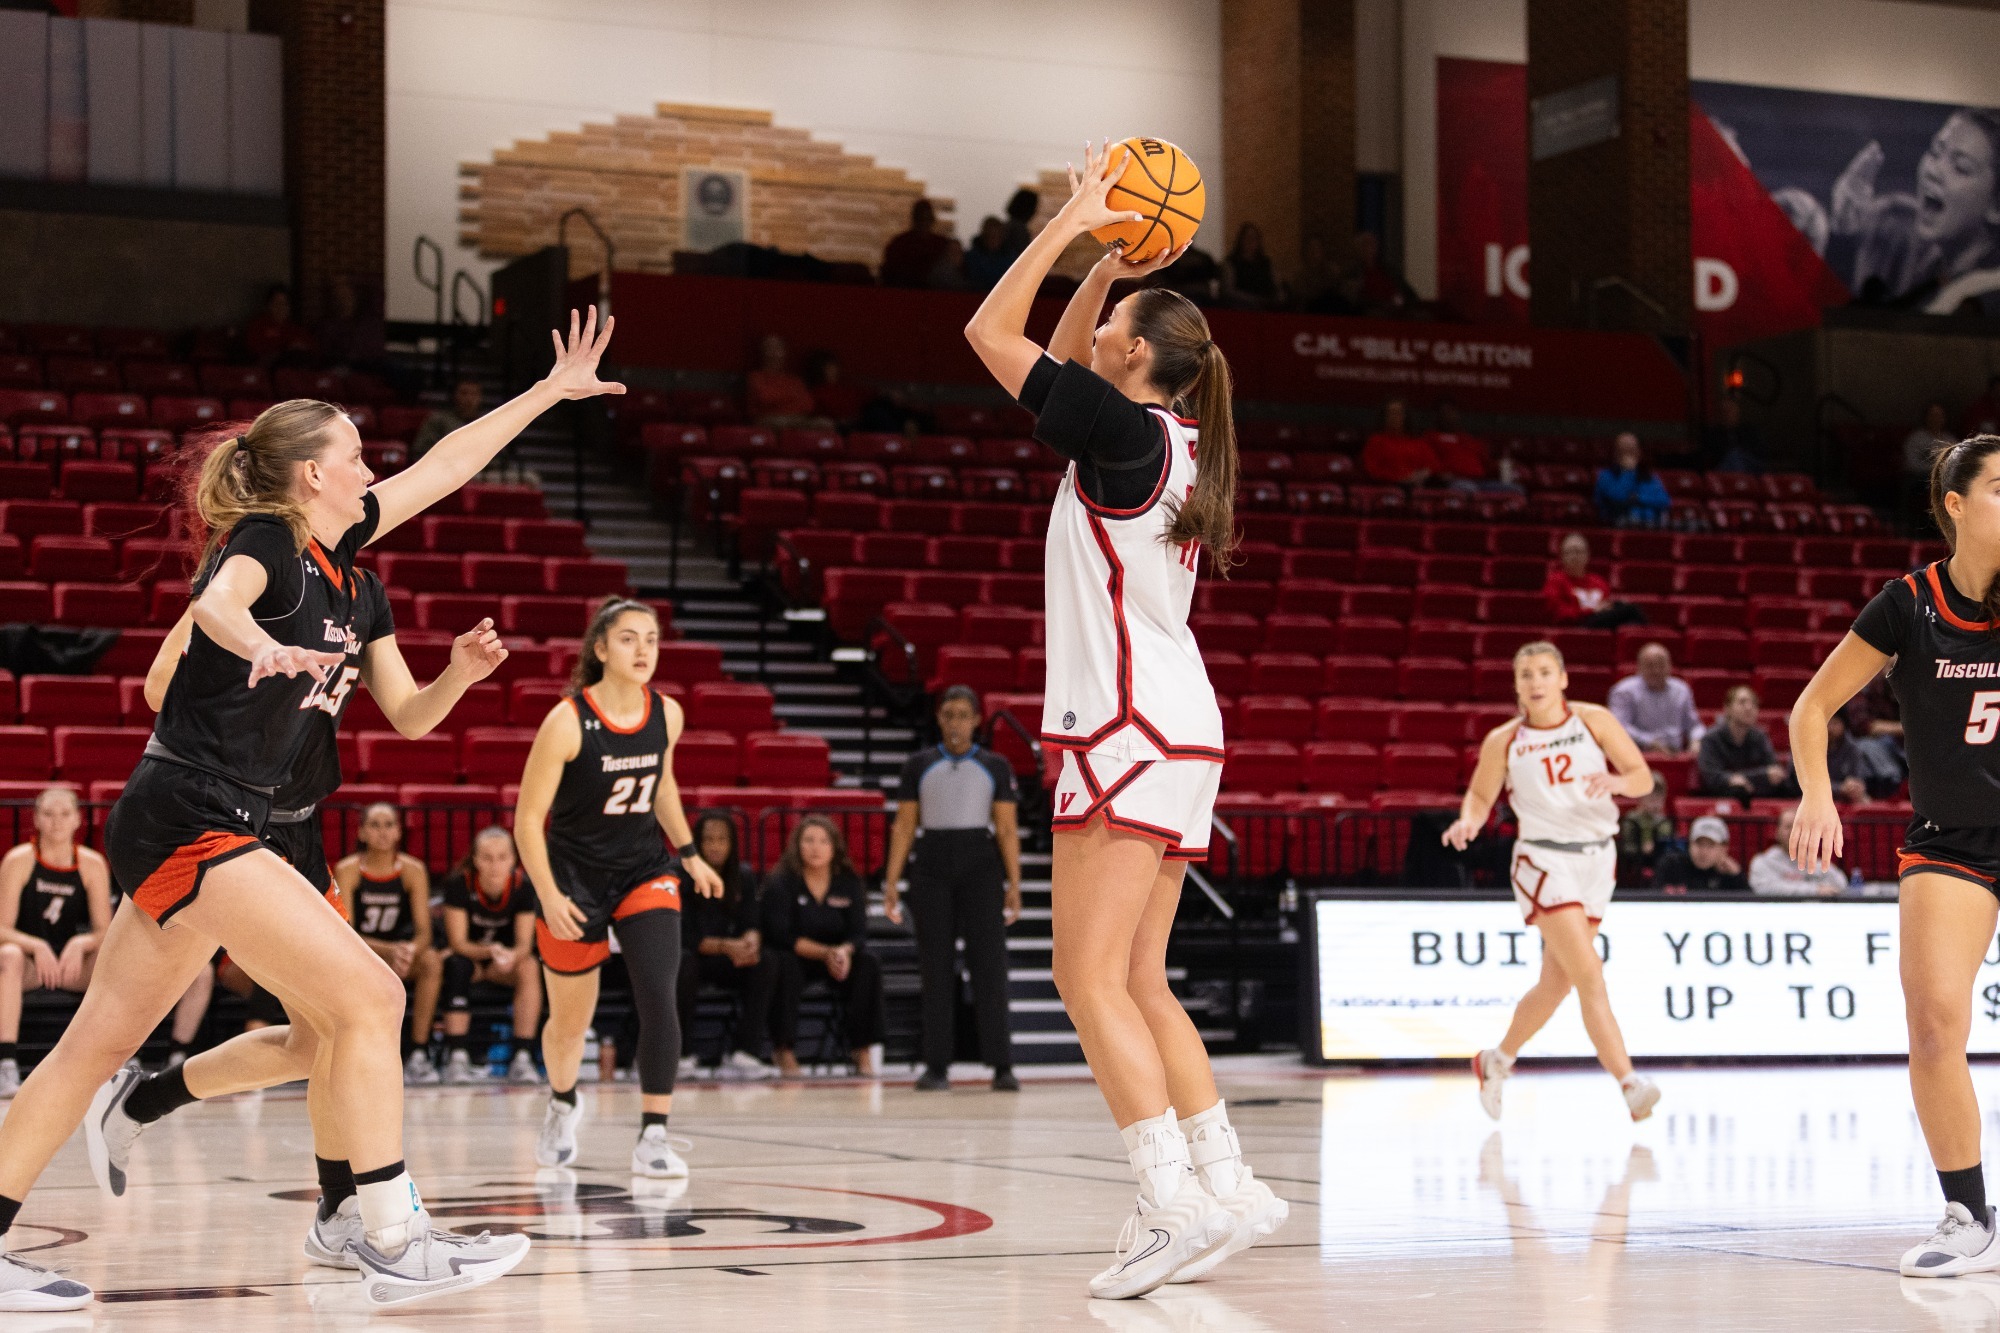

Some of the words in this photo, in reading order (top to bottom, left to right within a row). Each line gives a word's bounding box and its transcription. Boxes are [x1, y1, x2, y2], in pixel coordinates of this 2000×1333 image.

[1432, 340, 1532, 368] GATTON
[1935, 658, 2000, 679] TUSCUL
[1541, 754, 1574, 787] 12
[603, 773, 657, 815] 21
[1060, 792, 1077, 813] V
[1664, 931, 1812, 966] YOUR
[1666, 985, 1733, 1020] UP
[1788, 985, 1855, 1020] TO
